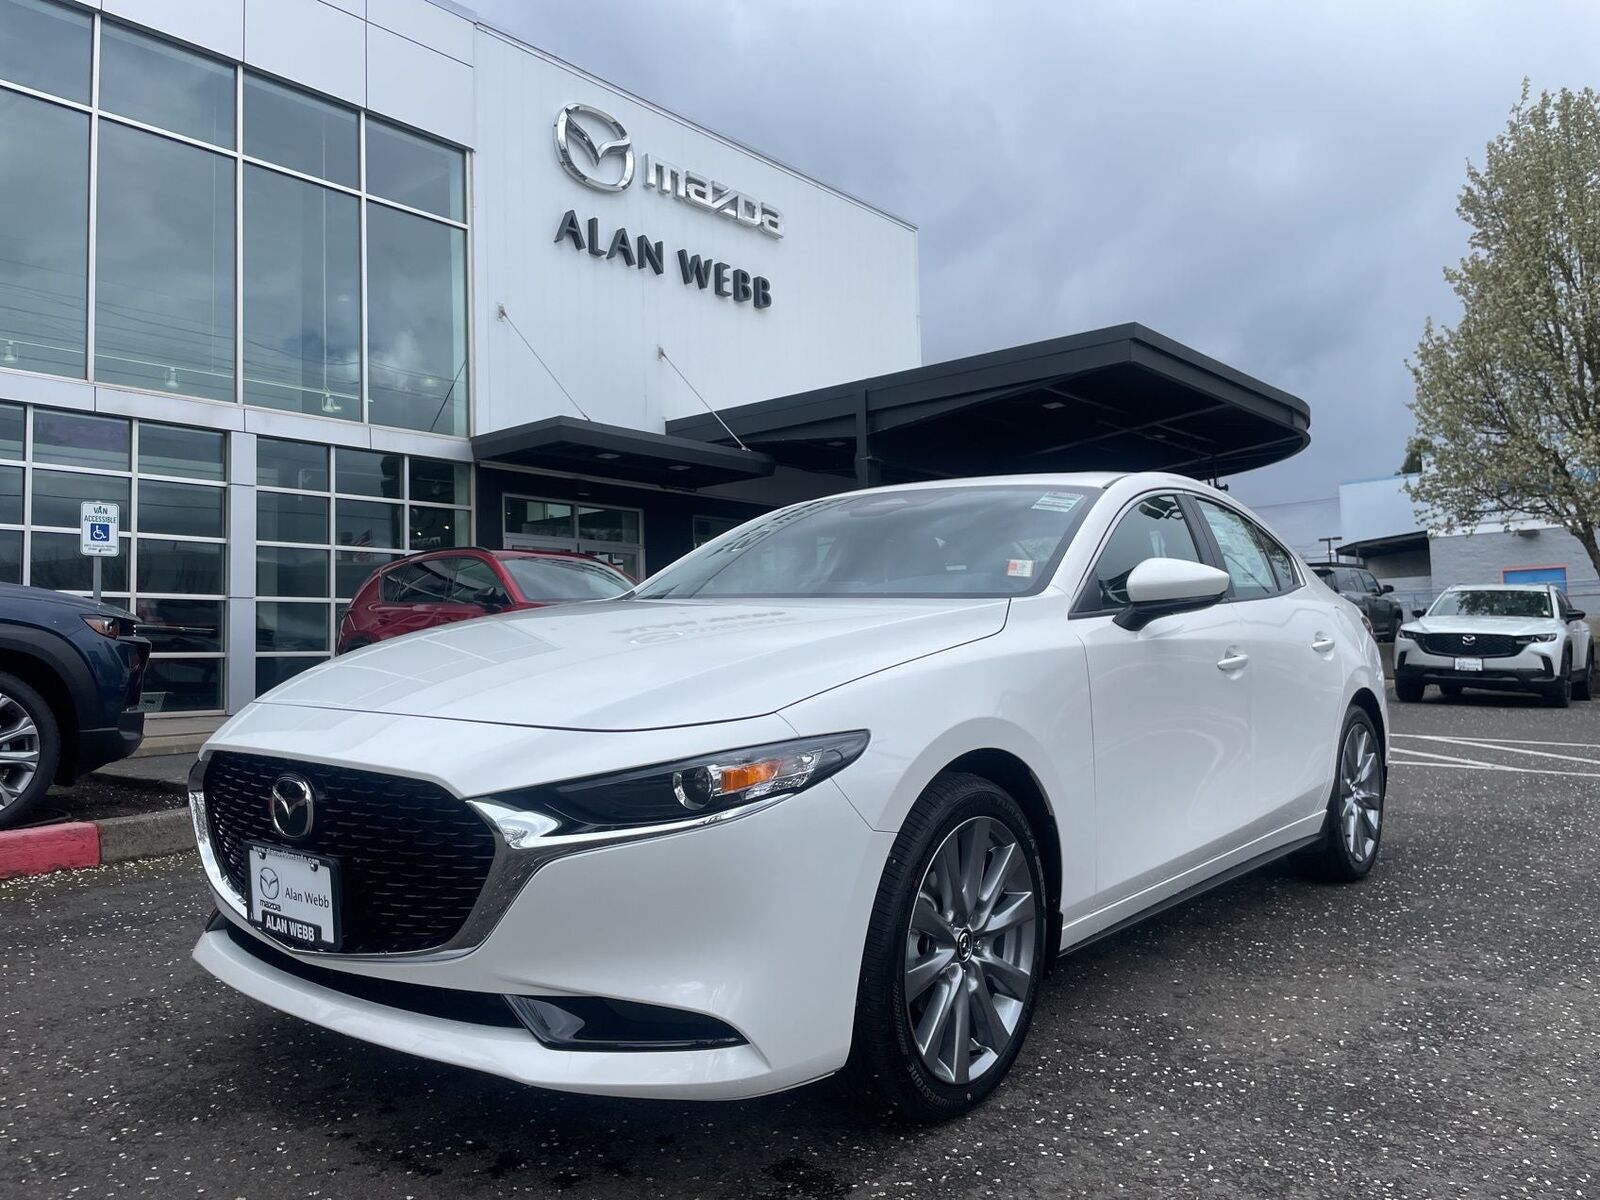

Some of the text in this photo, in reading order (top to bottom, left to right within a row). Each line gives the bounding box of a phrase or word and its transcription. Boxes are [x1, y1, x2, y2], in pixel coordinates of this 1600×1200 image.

[642, 153, 785, 239] mazda
[554, 209, 772, 309] ALAN WEBB
[84, 515, 117, 523] ACCESSIBLE
[93, 506, 108, 515] VAN
[260, 899, 281, 911] mazda
[285, 887, 330, 909] Alan Webb
[266, 914, 315, 942] ALAN WEBB
